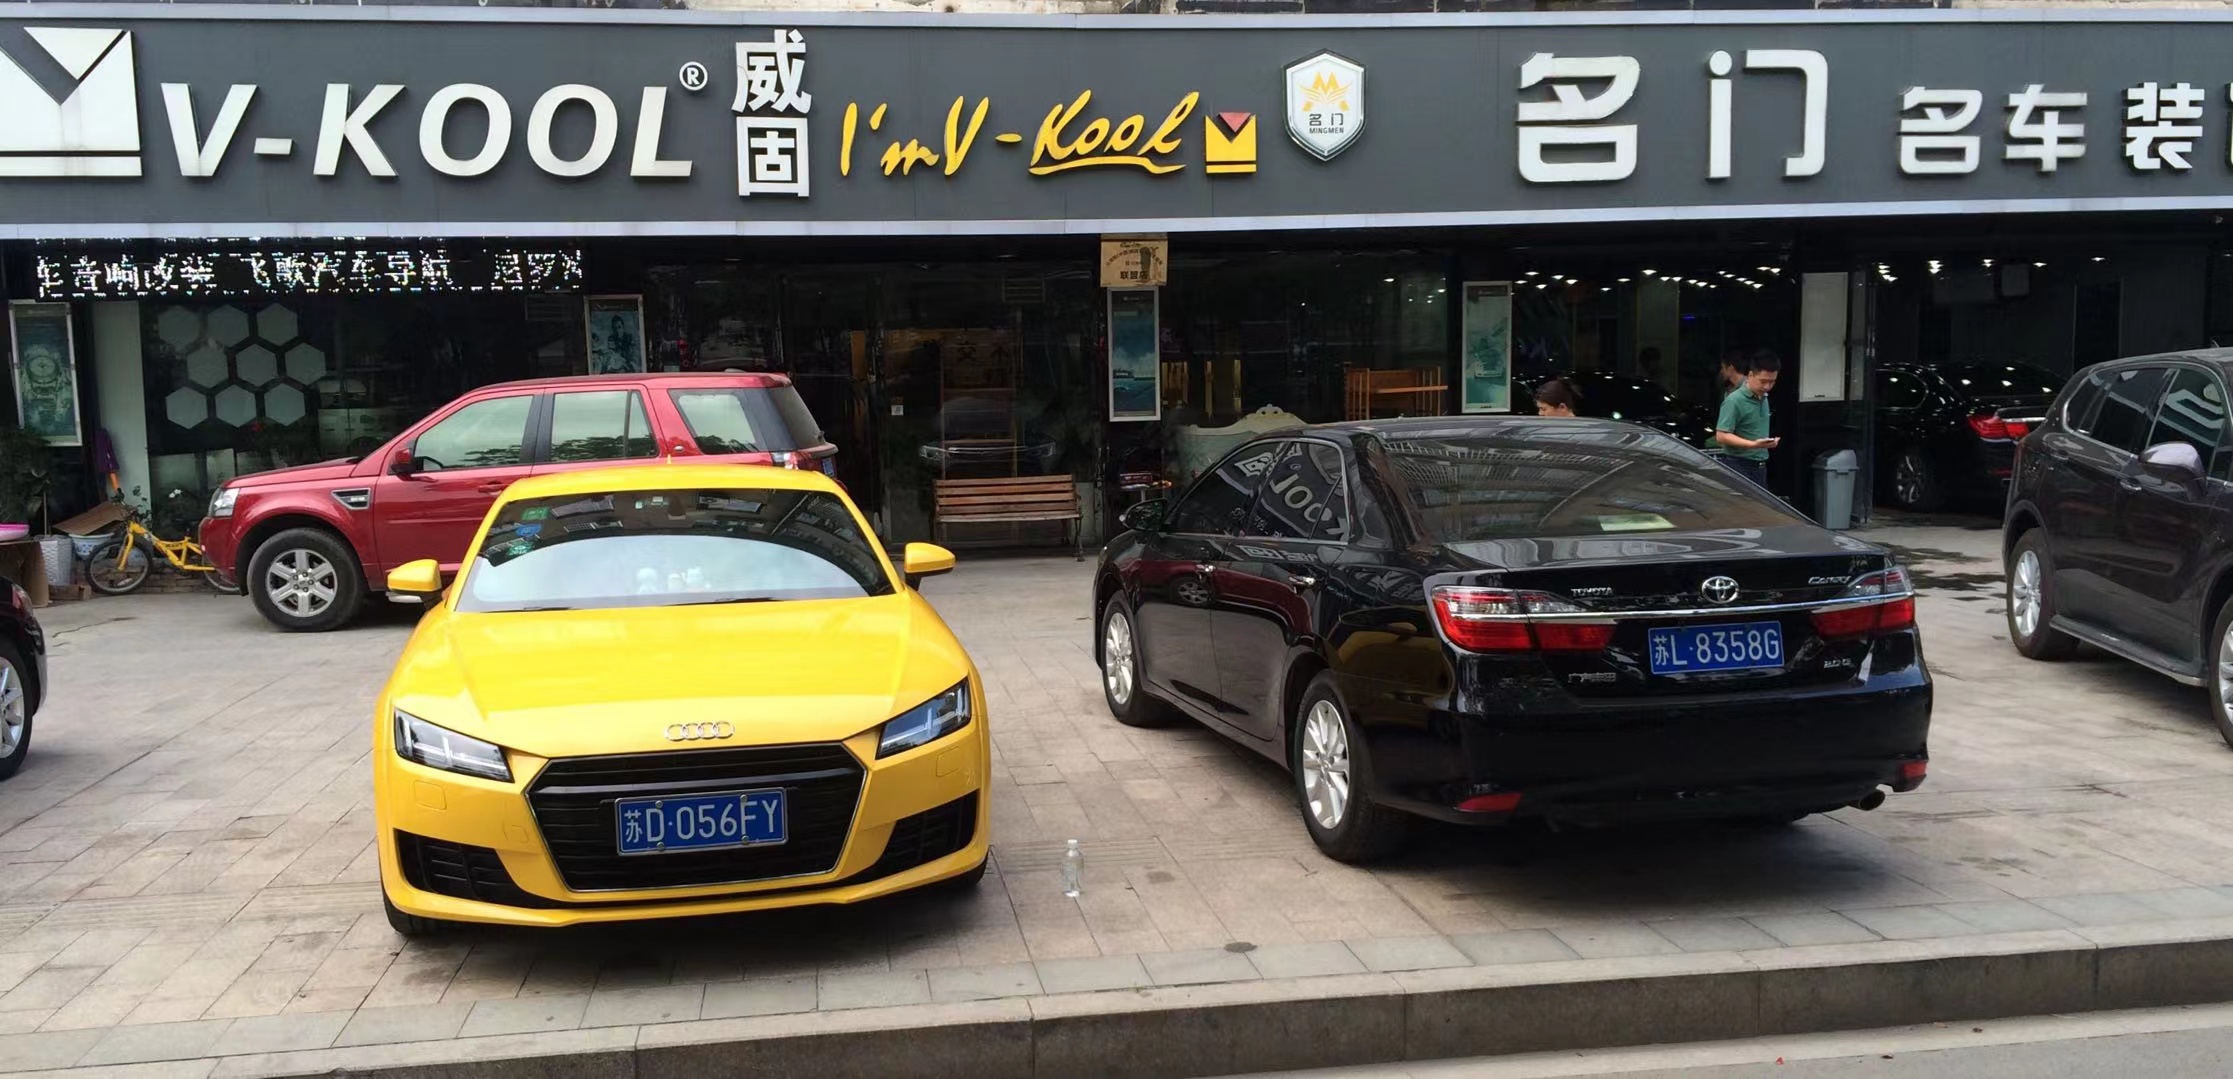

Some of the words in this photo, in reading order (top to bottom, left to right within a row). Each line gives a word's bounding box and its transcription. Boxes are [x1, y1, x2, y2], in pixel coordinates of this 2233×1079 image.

[161, 82, 693, 177] V-KOOL
[731, 29, 812, 197] 威固
[1309, 113, 1344, 127] 名门
[1309, 127, 1345, 135] MINGMEN
[1517, 49, 1829, 184] 名门
[1900, 82, 2233, 176] 名车装
[1570, 586, 1612, 597] TOYOTA
